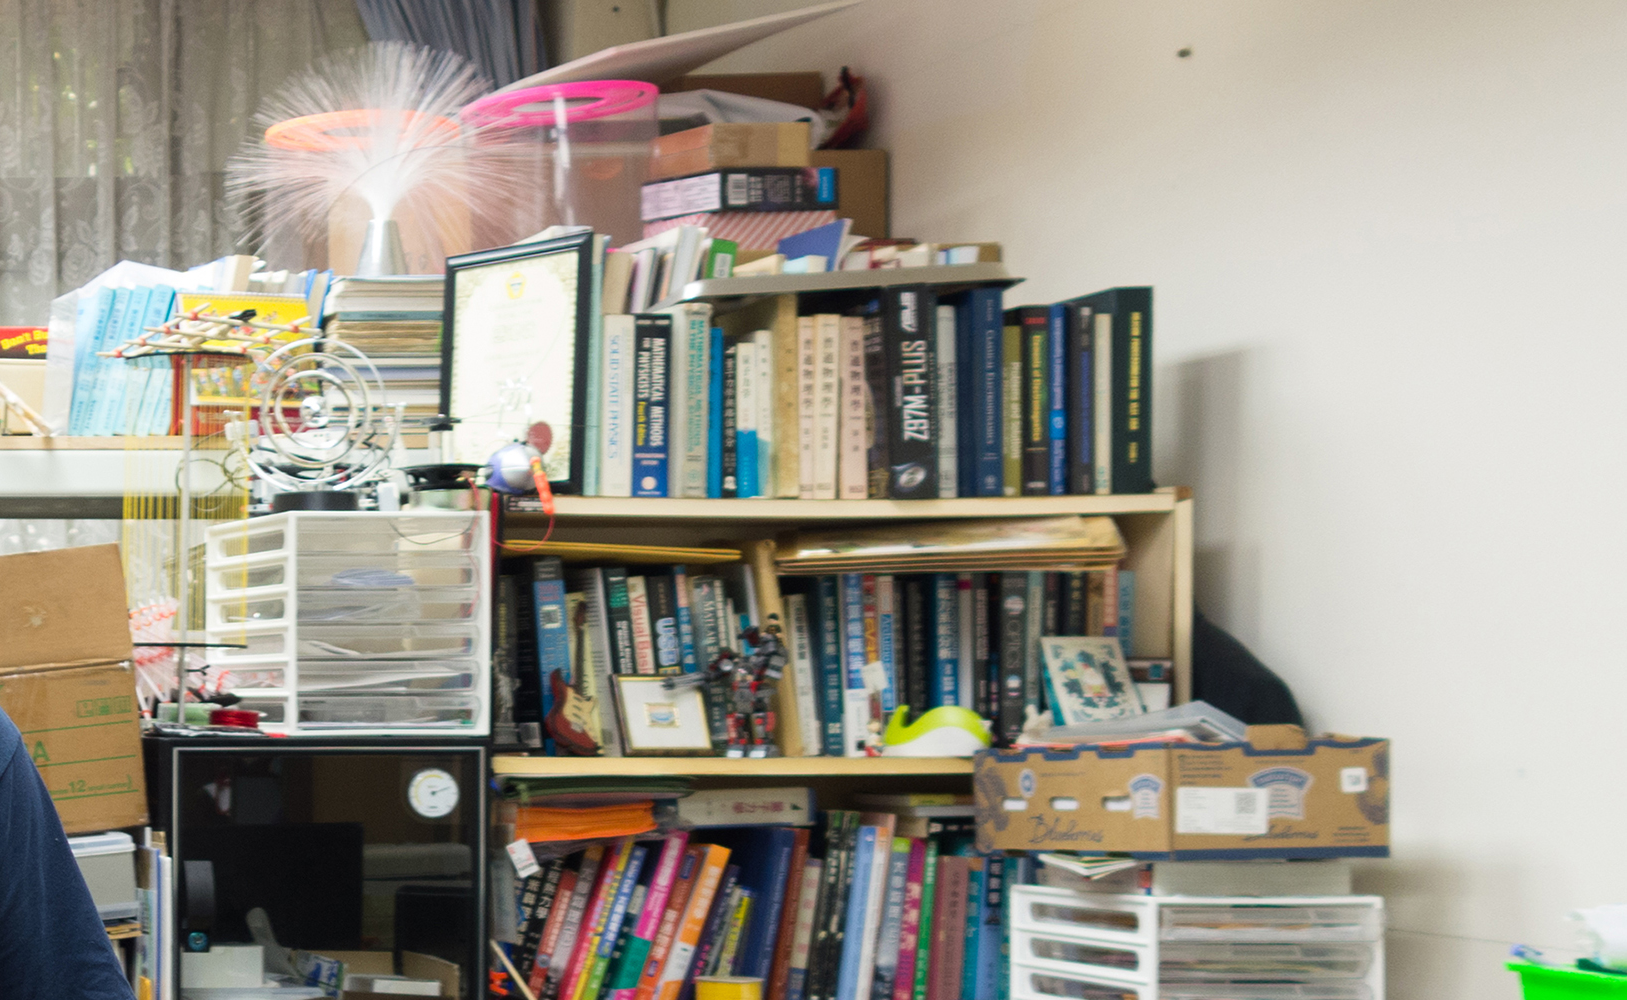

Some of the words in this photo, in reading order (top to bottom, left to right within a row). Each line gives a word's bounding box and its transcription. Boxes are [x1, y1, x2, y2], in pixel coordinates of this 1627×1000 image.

[637, 351, 651, 399] PHYSICISTS
[651, 338, 666, 402] MATHEMATICAL
[650, 406, 665, 447] METHODS
[632, 594, 651, 637] Visual
[637, 640, 654, 674] Basi
[655, 617, 680, 666] USB
[882, 616, 894, 661] Arduino
